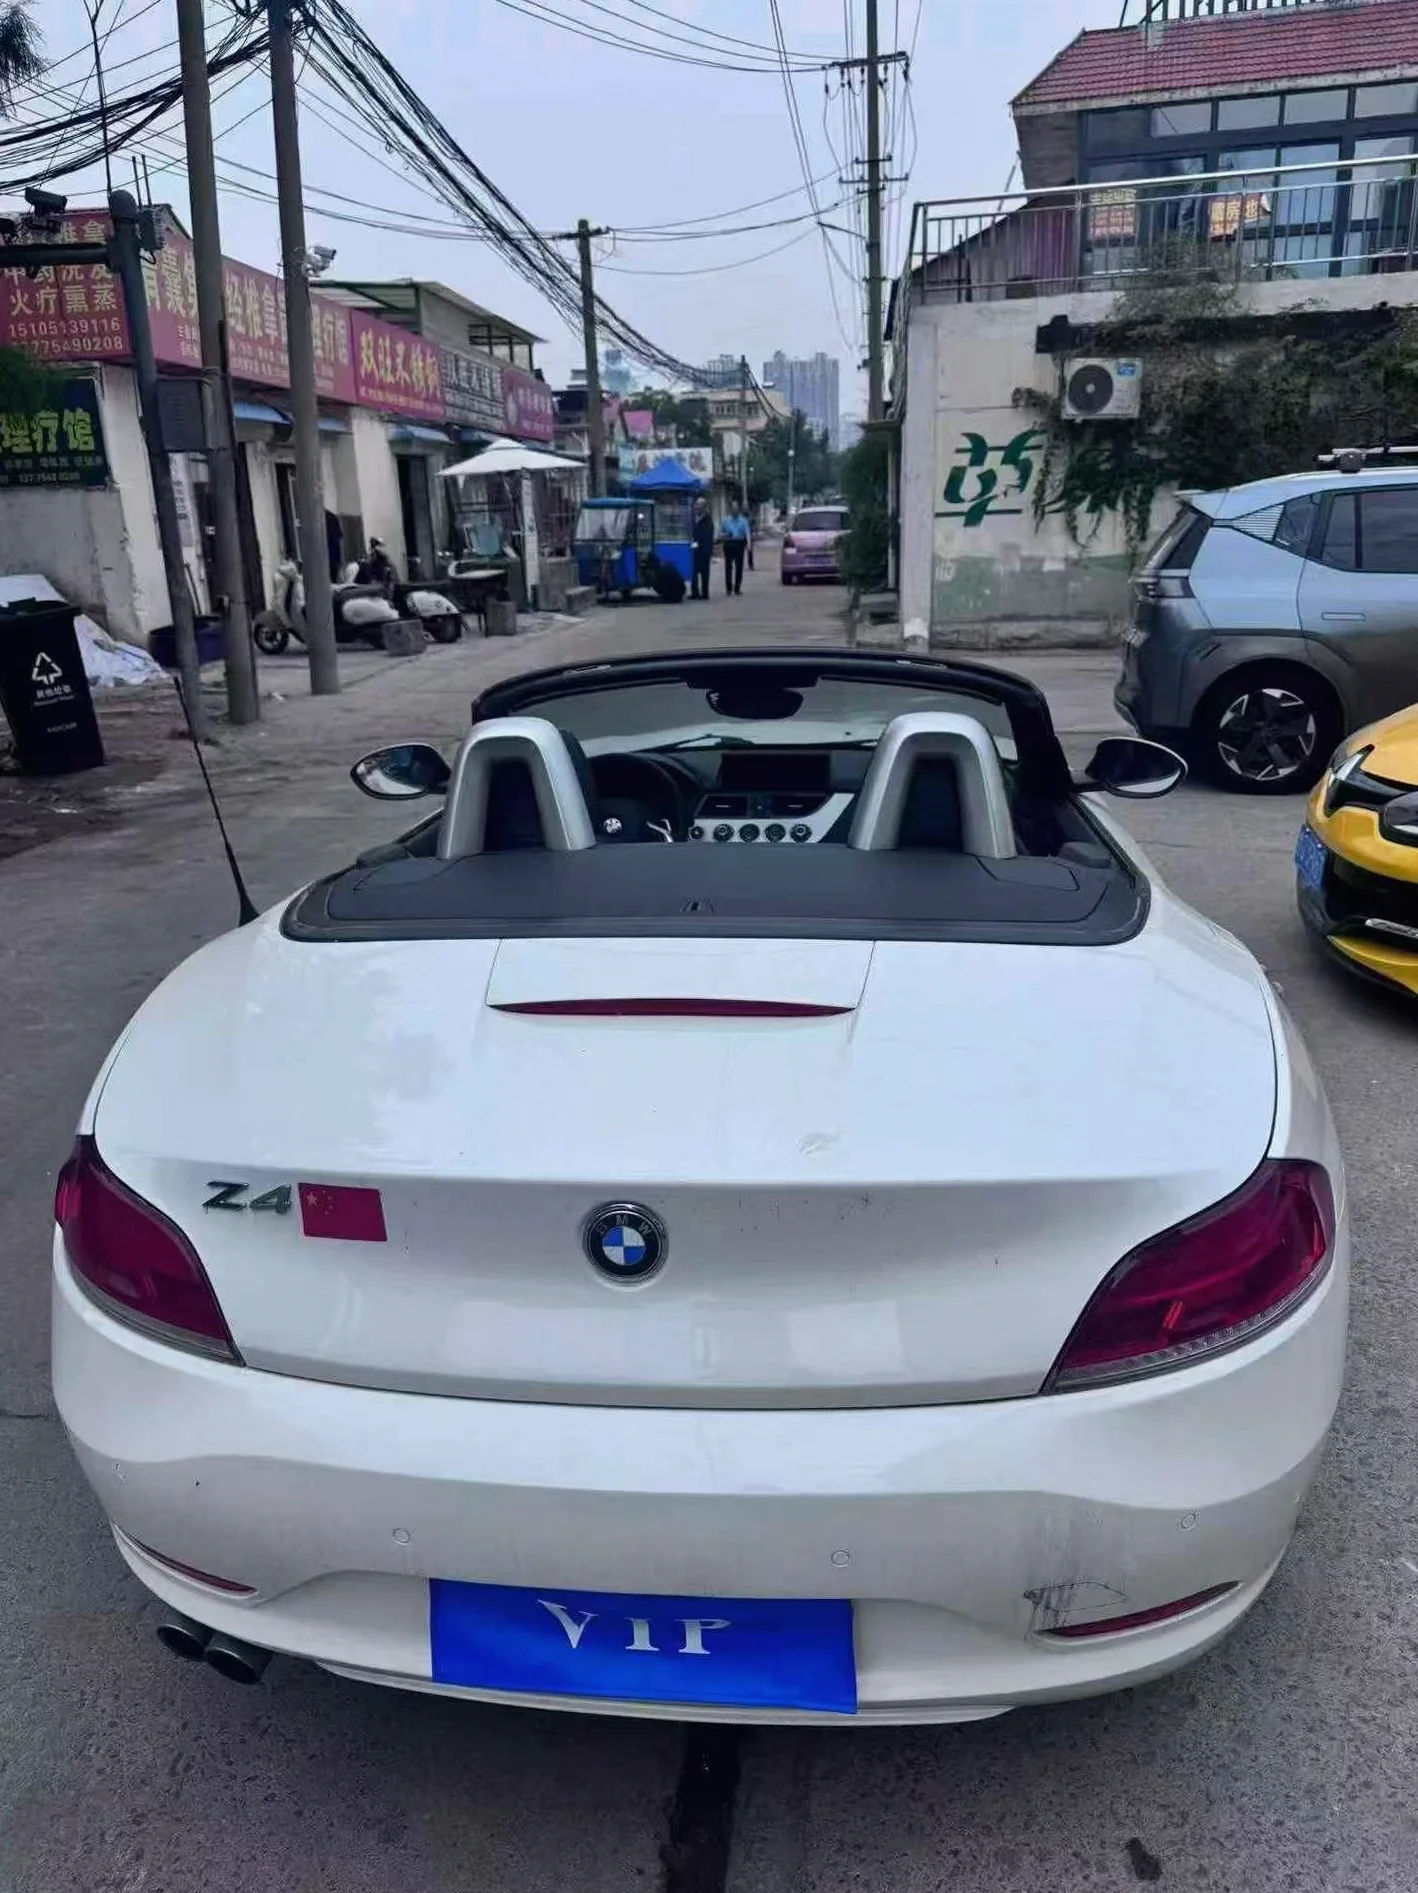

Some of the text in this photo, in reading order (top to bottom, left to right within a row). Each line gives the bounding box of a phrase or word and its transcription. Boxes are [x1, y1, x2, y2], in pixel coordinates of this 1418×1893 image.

[11, 335, 123, 354] 7775490208
[202, 1181, 291, 1215] Z4
[536, 1598, 732, 1656] VIP
